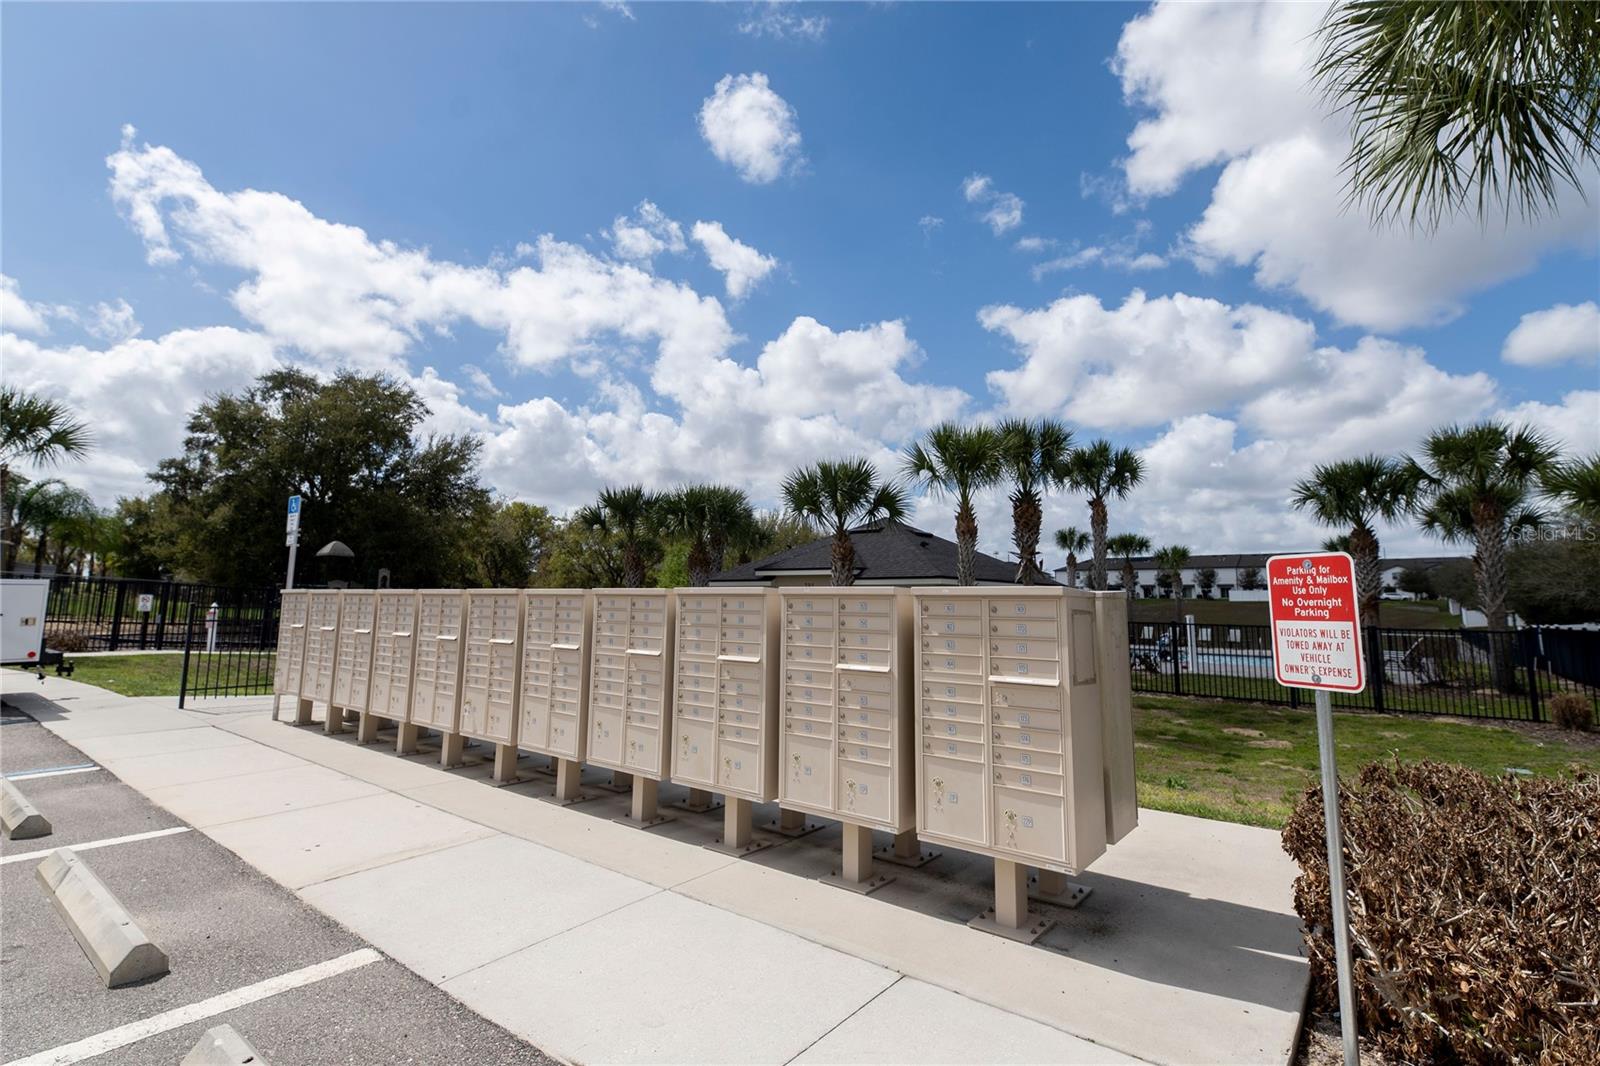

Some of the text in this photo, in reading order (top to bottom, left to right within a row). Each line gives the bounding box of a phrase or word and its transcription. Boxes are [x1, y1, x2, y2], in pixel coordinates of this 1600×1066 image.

[1286, 565, 1330, 576] Parking for
[1273, 575, 1348, 586] Amenity & Mailbox
[1292, 585, 1327, 596] Use Only
[1281, 597, 1342, 609] No Overnight
[1294, 608, 1329, 619] Parking
[1279, 627, 1351, 639] VIOLATORS WILL BE
[1286, 640, 1345, 652] TOWED AWAY AT
[1300, 653, 1331, 664] VEHICLE
[1284, 664, 1352, 678] OWNER'S EXPENSE
